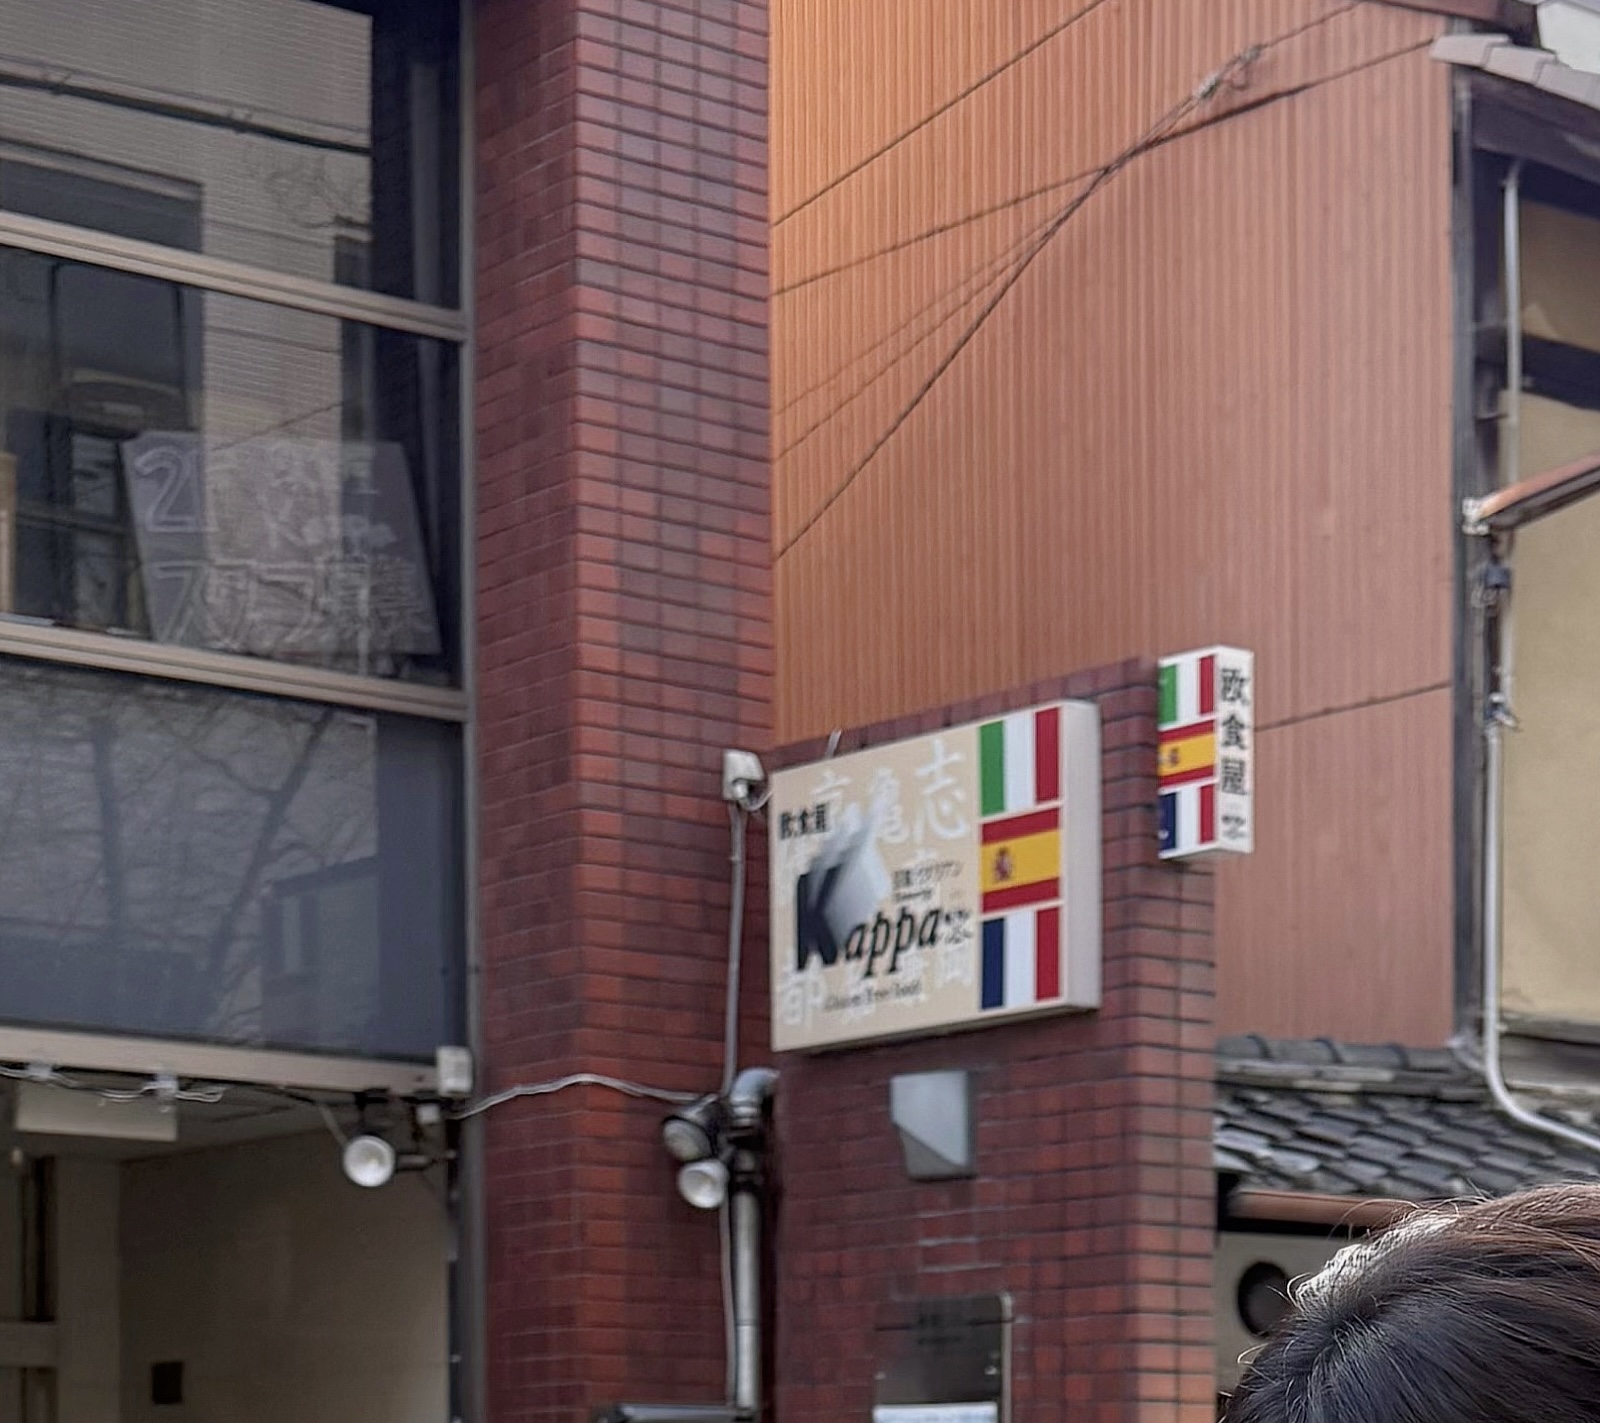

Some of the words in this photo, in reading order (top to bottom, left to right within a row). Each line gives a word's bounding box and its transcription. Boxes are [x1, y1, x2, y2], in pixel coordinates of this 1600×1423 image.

[1221, 667, 1250, 796] 欧食屋
[796, 864, 941, 977] Kappa
